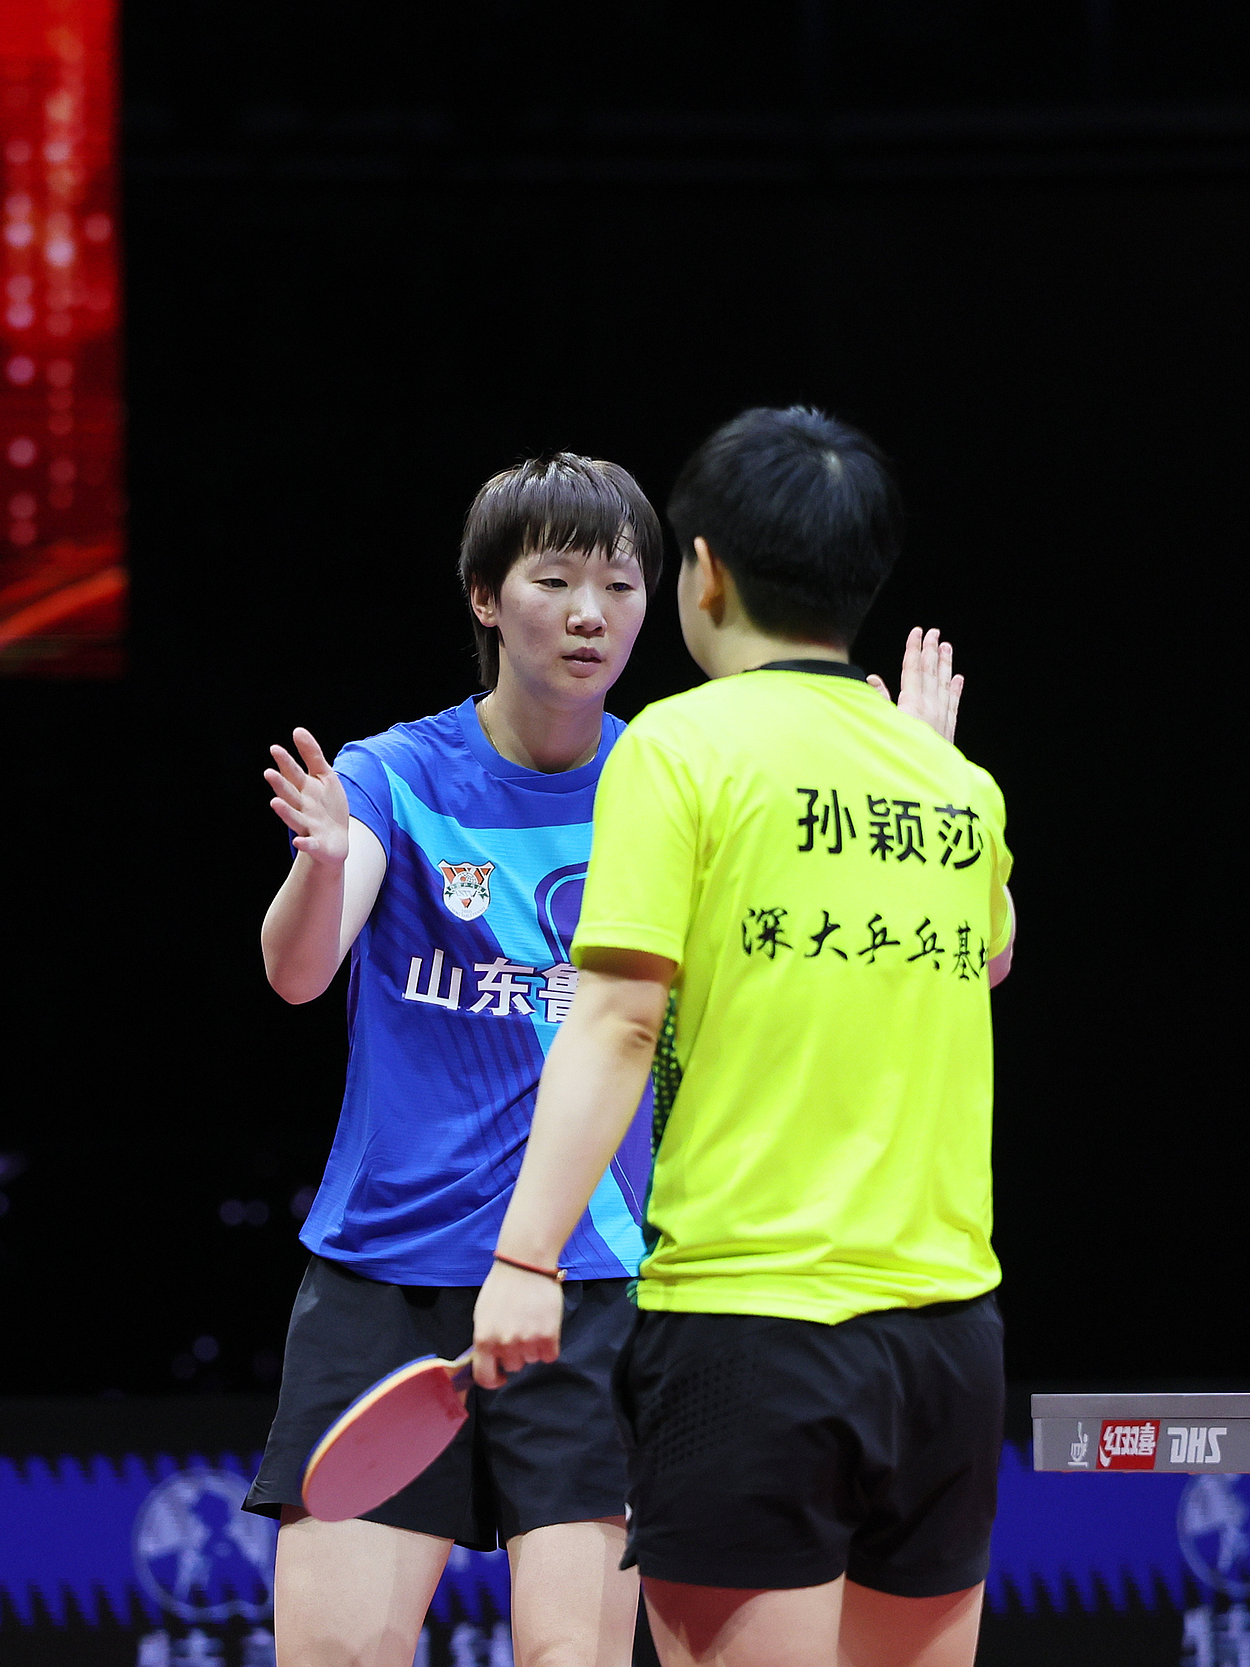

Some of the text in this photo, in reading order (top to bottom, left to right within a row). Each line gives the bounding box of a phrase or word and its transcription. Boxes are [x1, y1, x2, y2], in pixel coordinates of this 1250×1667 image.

[797, 787, 984, 869] 孙颖莎
[1100, 1422, 1227, 1467] 红双喜 DHS
